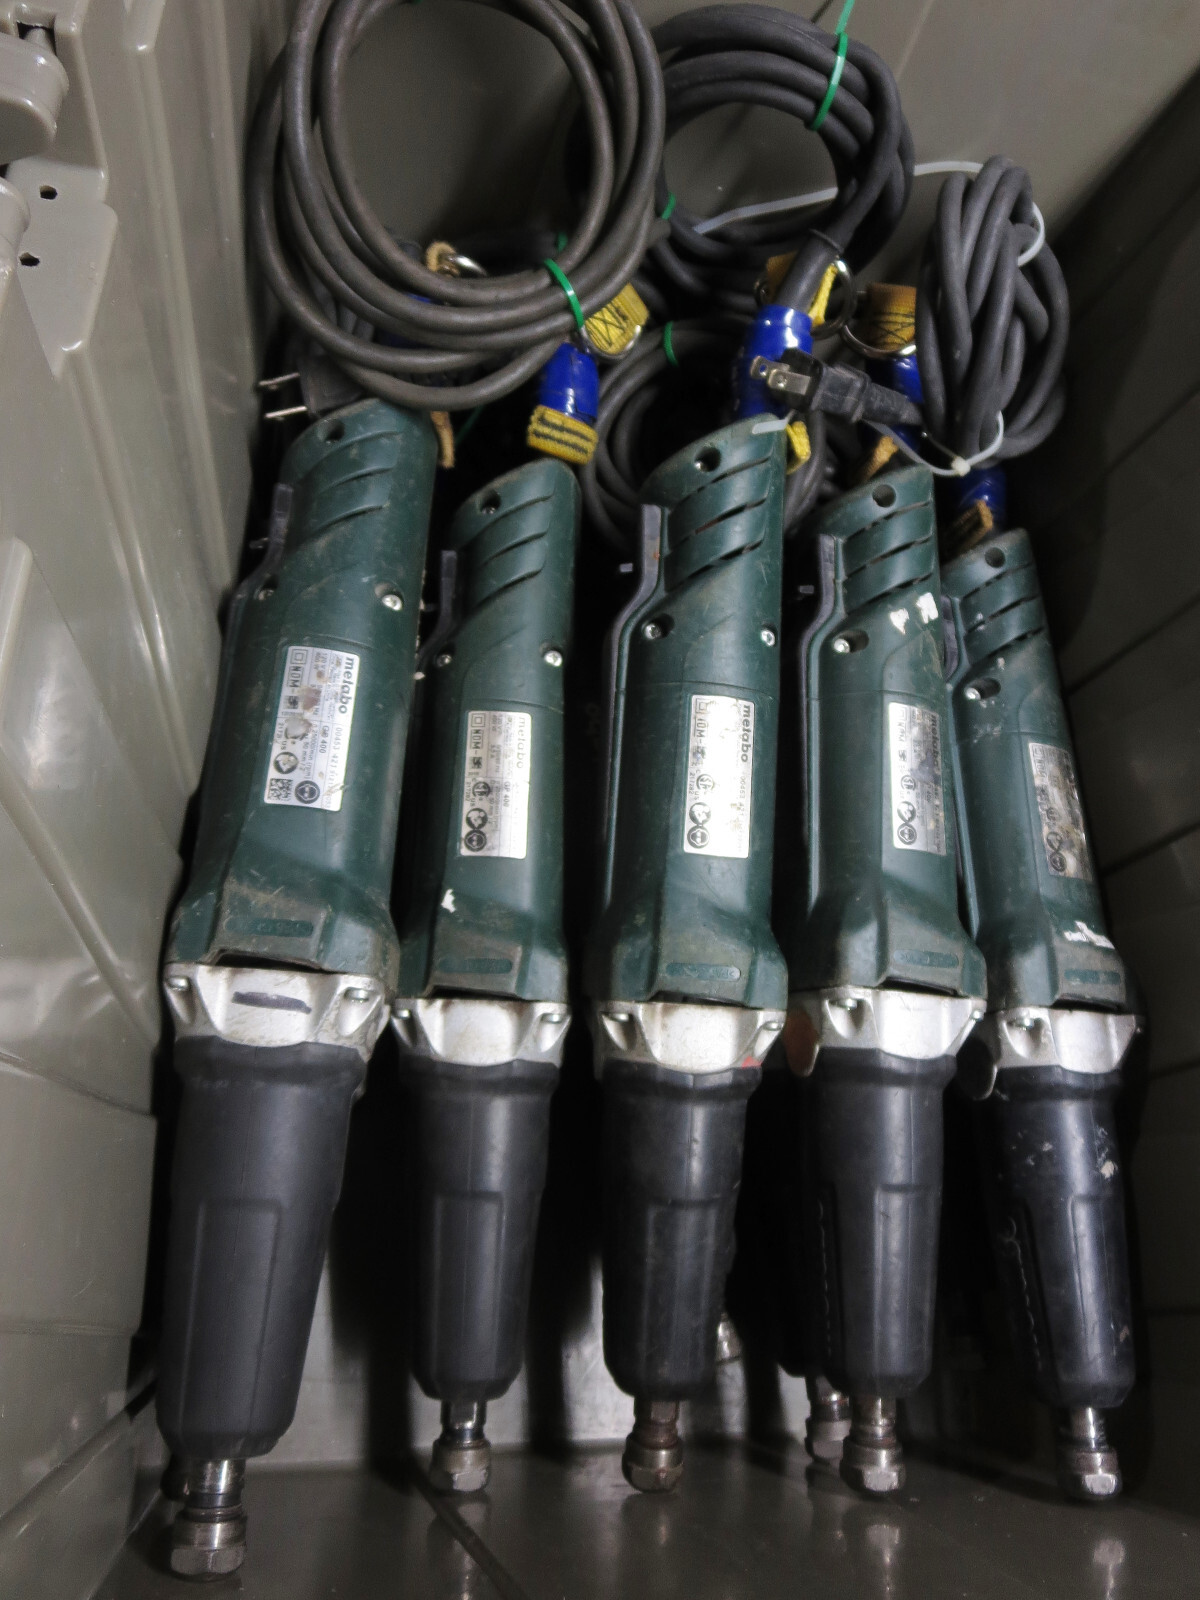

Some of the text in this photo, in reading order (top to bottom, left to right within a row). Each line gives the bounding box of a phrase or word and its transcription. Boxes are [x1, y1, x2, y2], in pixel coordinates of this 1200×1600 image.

[338, 657, 355, 714] metabo
[319, 739, 328, 753] 400
[472, 729, 482, 749] NOM
[516, 717, 527, 769] metabo
[740, 704, 751, 763] metabo
